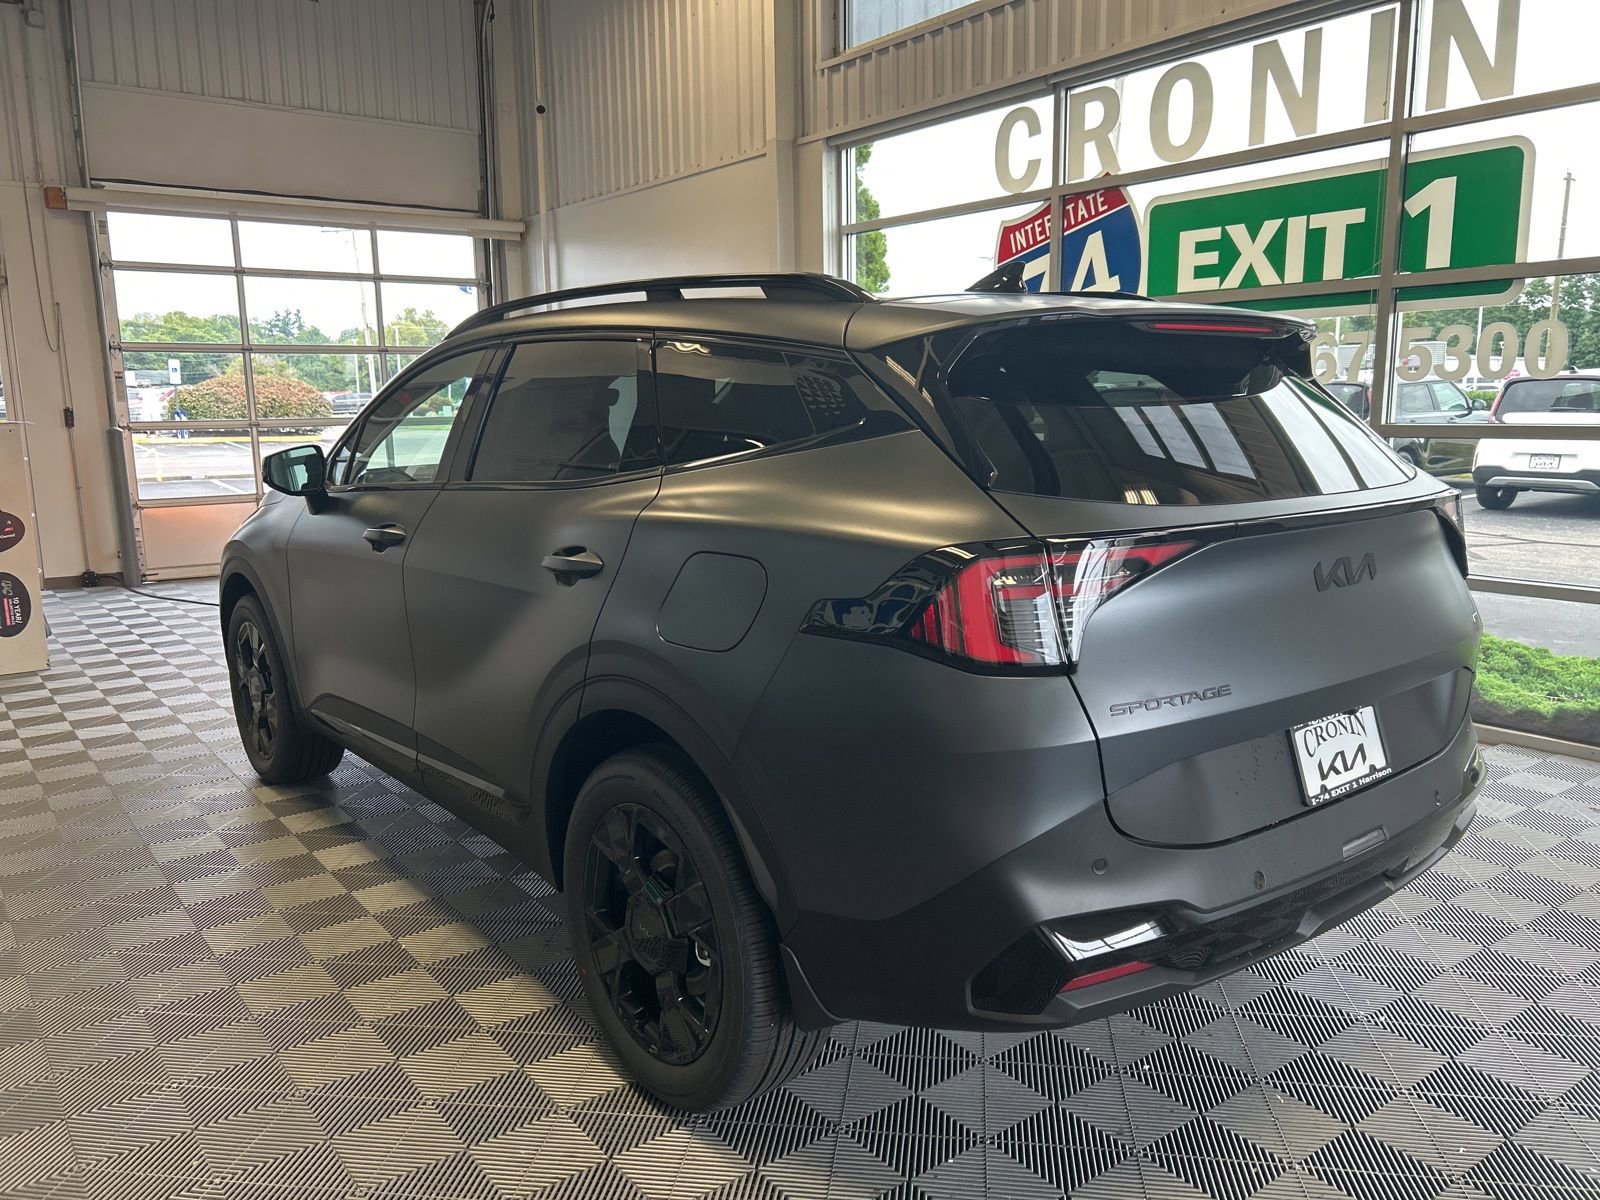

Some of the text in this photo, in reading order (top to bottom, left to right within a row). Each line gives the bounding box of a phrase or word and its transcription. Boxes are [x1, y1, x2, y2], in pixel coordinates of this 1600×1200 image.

[994, 0, 1522, 194] CRONIN
[1177, 176, 1458, 294] EXIT 1
[1395, 319, 1569, 382] 5300
[1313, 552, 1377, 592] KIA
[1109, 684, 1233, 717] SPORTAGE
[1303, 711, 1368, 758] CRONIN
[1317, 742, 1368, 782] KIA
[1311, 767, 1393, 806] I-74 EXIT 1 Harrison
